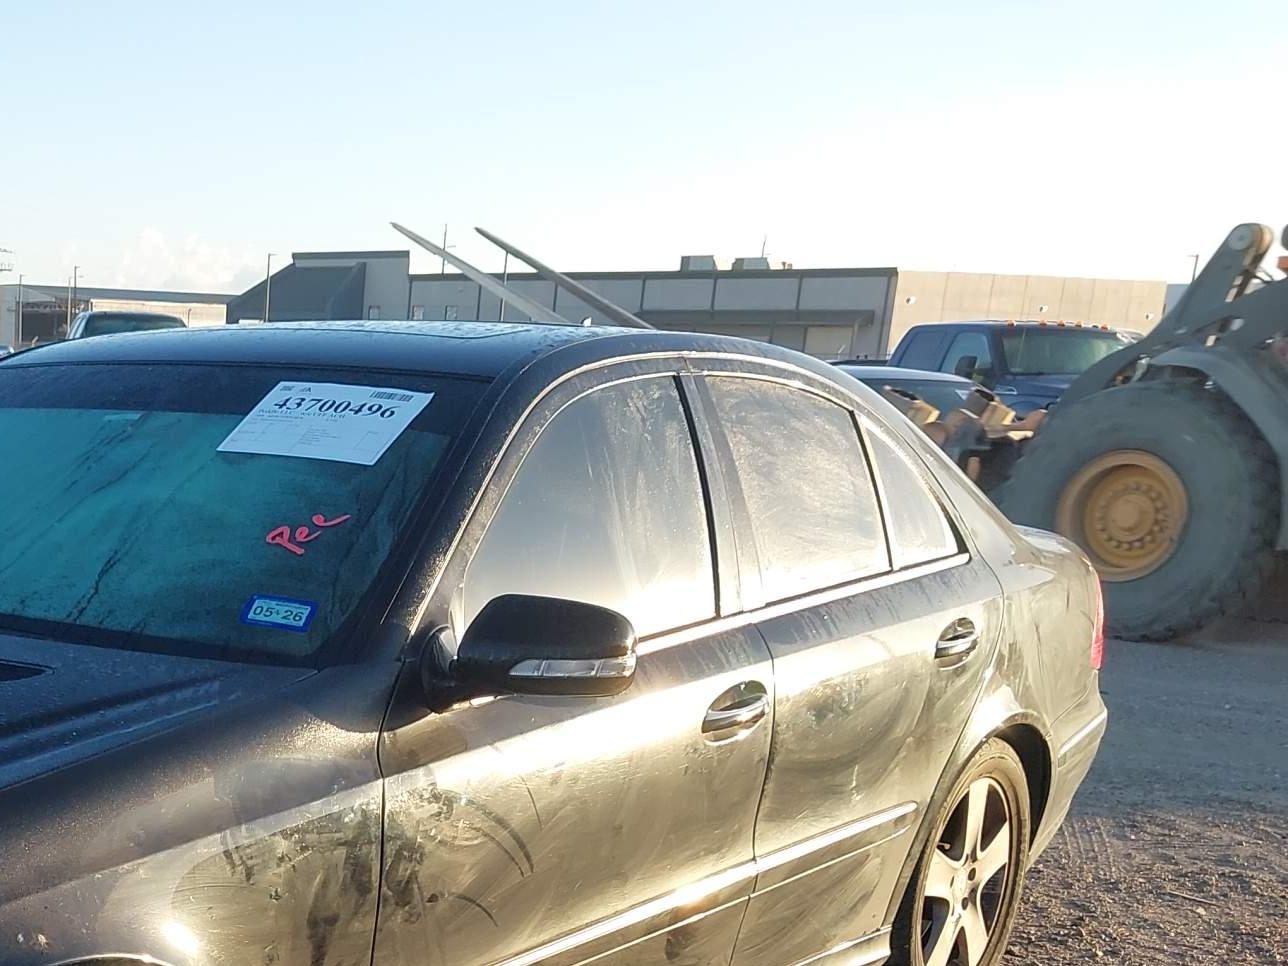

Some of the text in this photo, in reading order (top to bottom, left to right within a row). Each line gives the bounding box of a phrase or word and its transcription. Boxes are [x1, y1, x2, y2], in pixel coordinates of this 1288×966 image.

[273, 396, 401, 419] 43700496
[252, 605, 305, 622] 05 26
